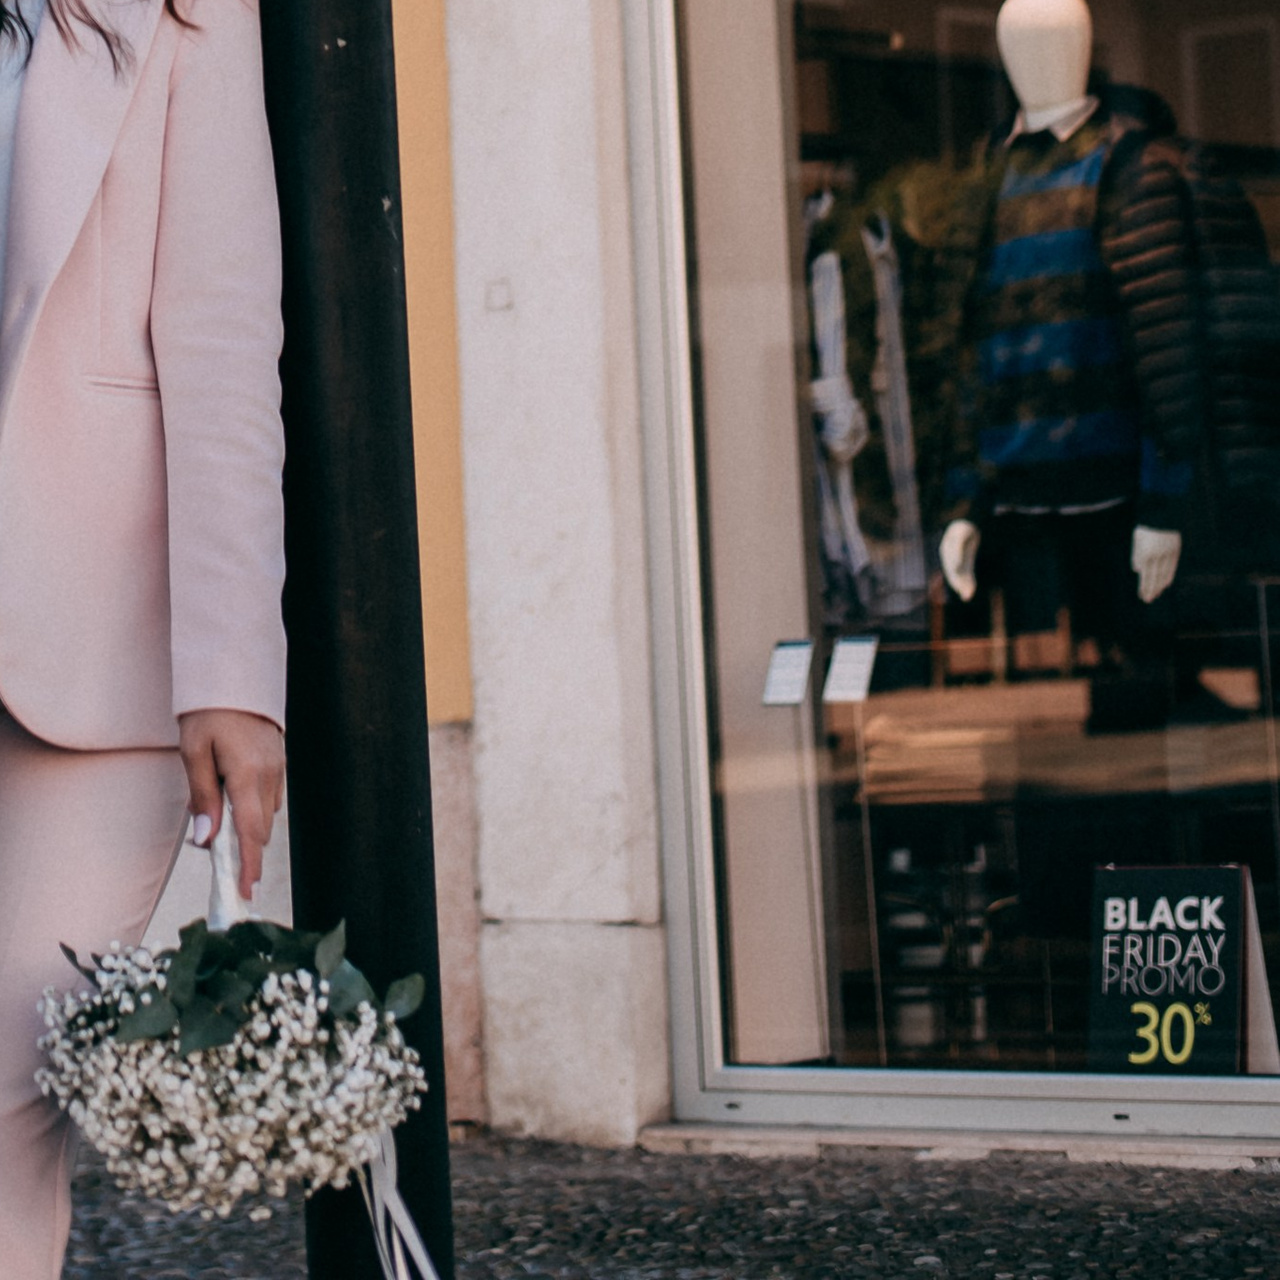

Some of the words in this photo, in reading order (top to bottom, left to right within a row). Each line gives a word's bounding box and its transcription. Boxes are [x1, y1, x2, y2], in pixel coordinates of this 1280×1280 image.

[1103, 896, 1227, 931] BLACK
[1102, 932, 1227, 968] FRIDAY
[1101, 963, 1226, 996] PROMO
[1128, 1001, 1212, 1065] 30%
